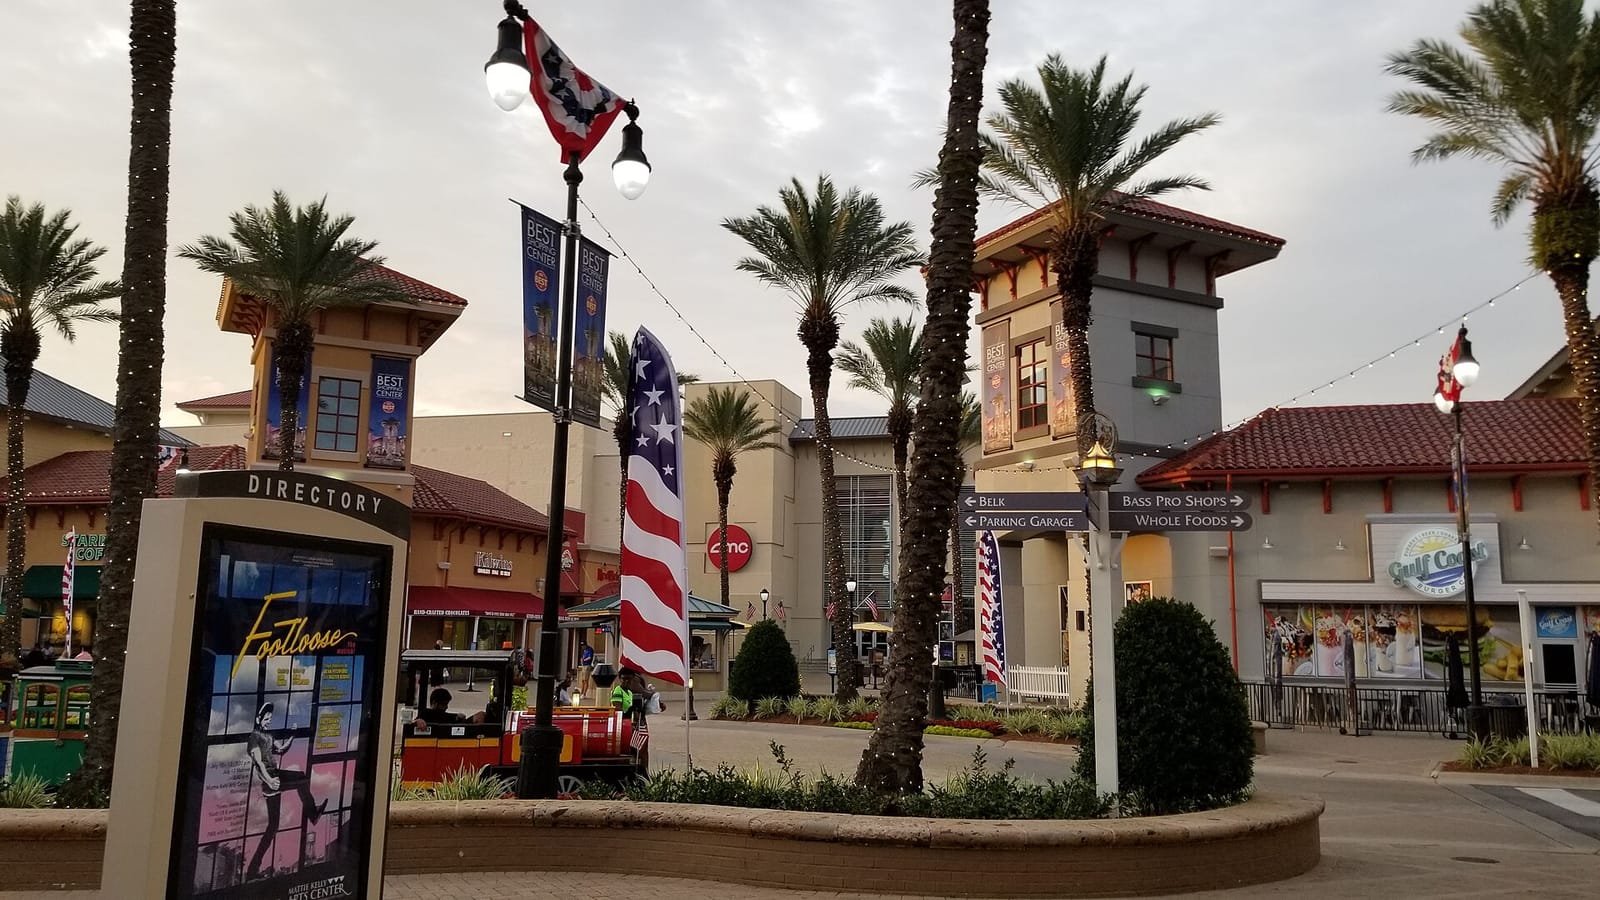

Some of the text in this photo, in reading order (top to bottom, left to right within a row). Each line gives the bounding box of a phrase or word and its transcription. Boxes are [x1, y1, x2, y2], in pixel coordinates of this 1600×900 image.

[527, 219, 556, 247] BEST
[526, 246, 556, 266] CENTER
[583, 248, 606, 273] BEST
[581, 273, 604, 293] CENTER
[986, 343, 1006, 360] BEST
[986, 360, 1006, 372] CENTER
[377, 375, 404, 388] BEST
[375, 389, 403, 399] CENTER
[248, 475, 381, 514] DIRECTORY
[979, 496, 1006, 507] BELK
[1123, 495, 1227, 507] BASS PRO SHOPS
[980, 515, 1075, 527] PARKING GARAGE
[1135, 514, 1228, 526] WHOLE FOODS
[76, 547, 104, 561] COF
[710, 542, 749, 554] amc
[475, 551, 513, 571] Kilwins
[1388, 553, 1431, 585] Gulf
[1417, 584, 1458, 594] BURGER
[231, 590, 357, 679] Footloose
[287, 879, 328, 894] MATTIE KELLY
[310, 883, 352, 900] CENTER
